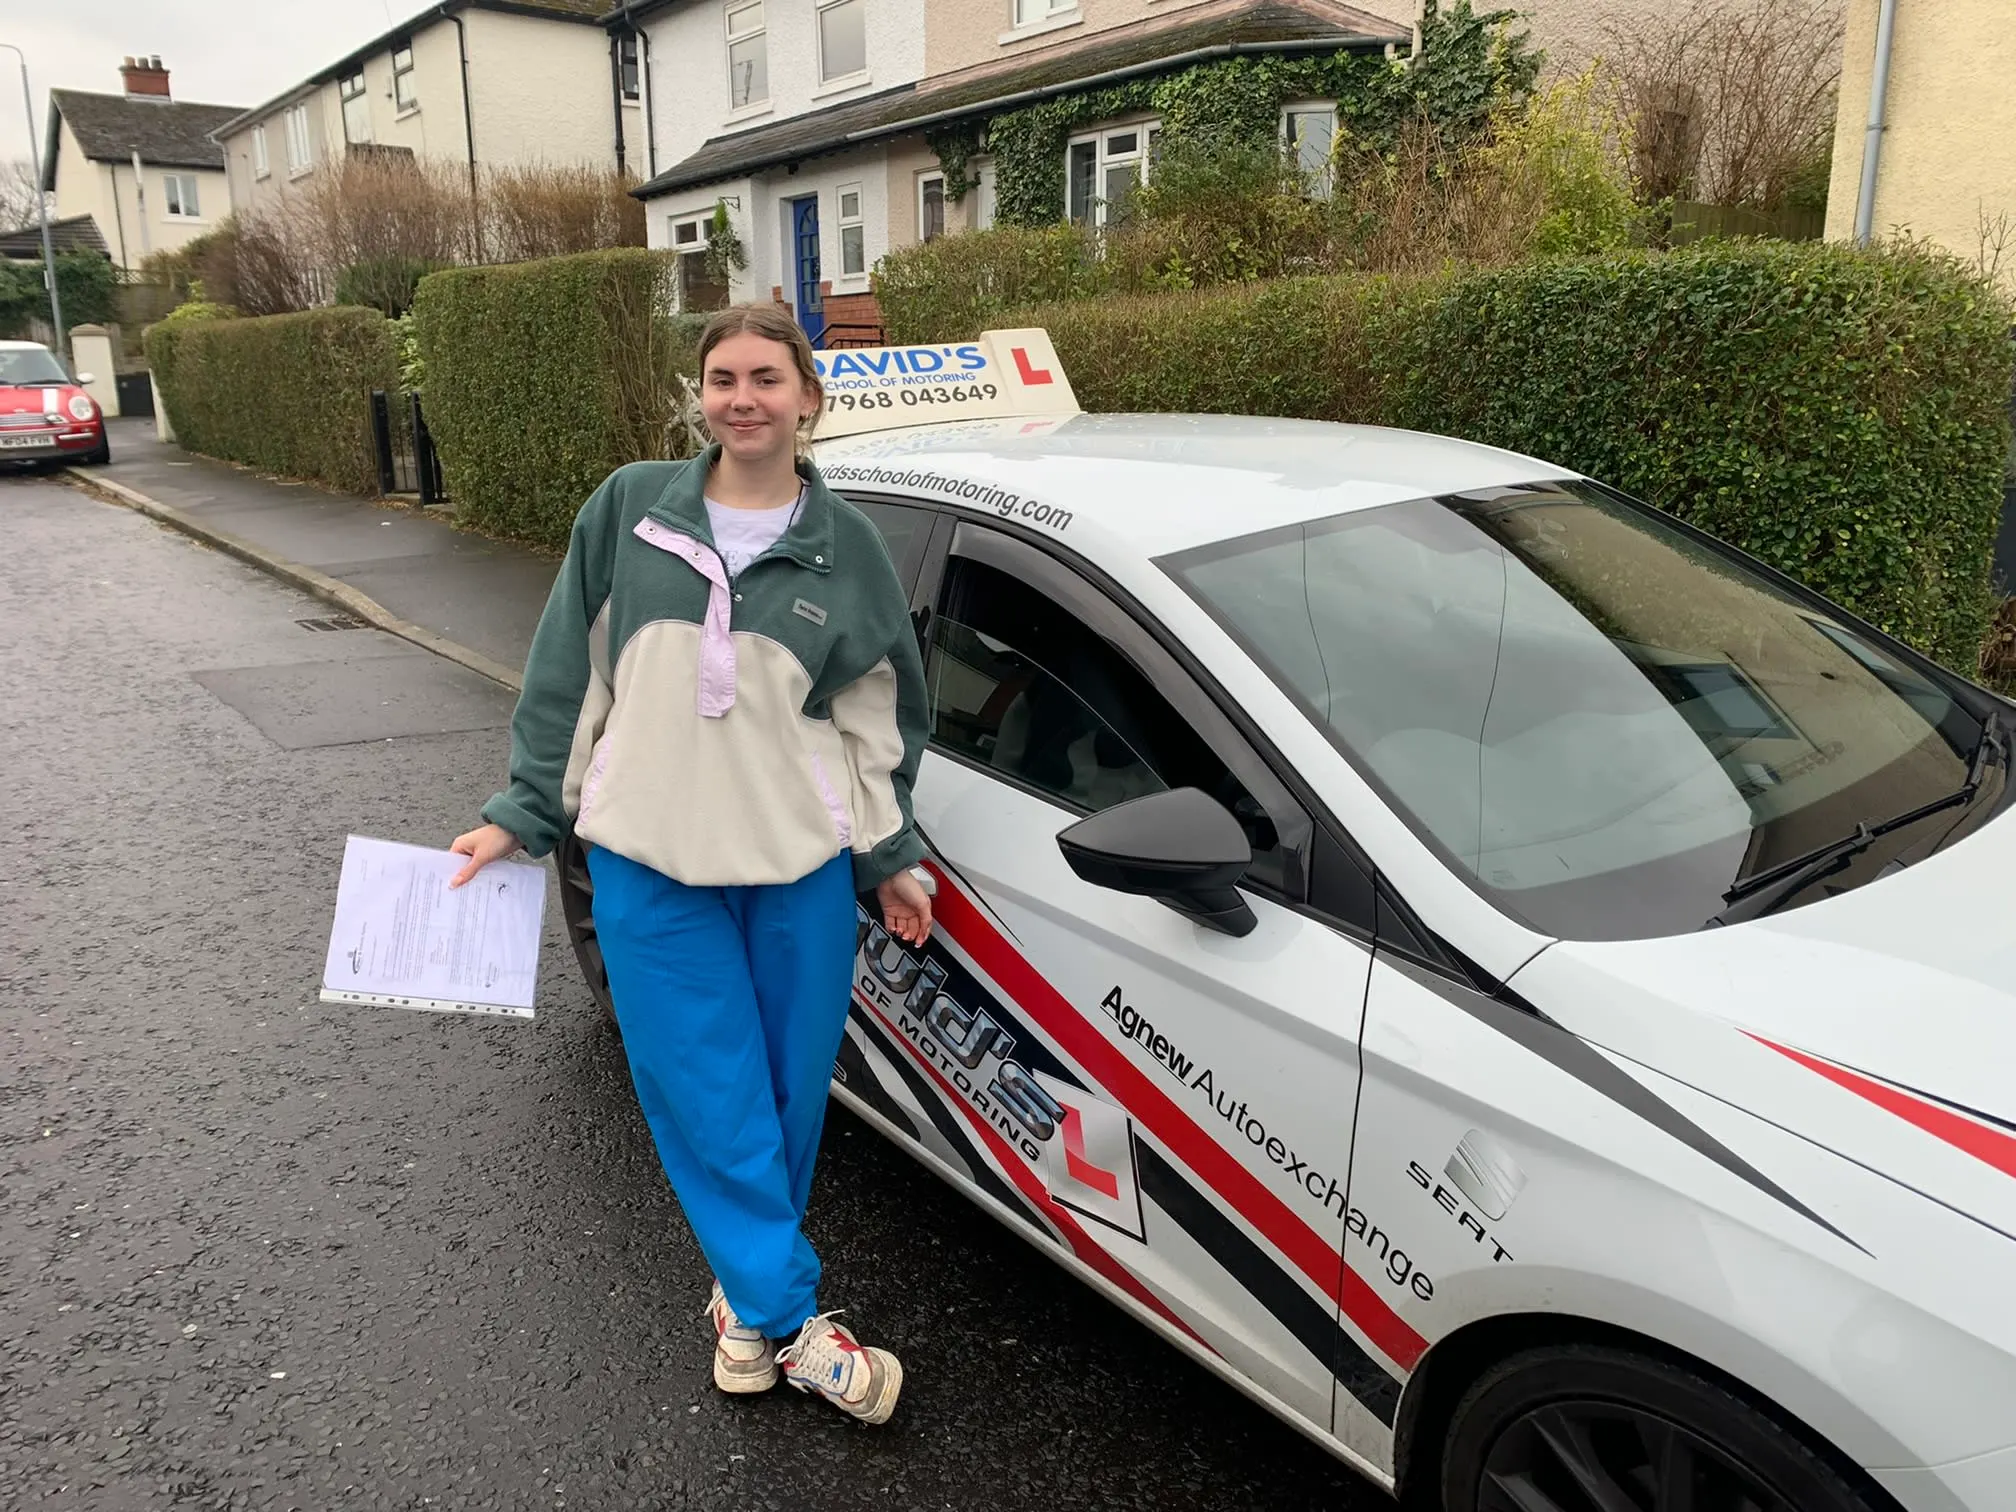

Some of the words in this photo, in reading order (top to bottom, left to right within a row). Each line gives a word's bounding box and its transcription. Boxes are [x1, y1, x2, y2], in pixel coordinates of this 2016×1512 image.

[824, 379, 877, 391] CHOOL
[880, 377, 897, 387] OF
[902, 372, 976, 384] MOTORING
[826, 391, 893, 412] 7968
[900, 383, 998, 406] 043649
[1010, 348, 1054, 386] L
[856, 902, 1067, 1141] vid's
[860, 975, 892, 1008] OF
[898, 1016, 1040, 1162] MOTORING
[1100, 985, 1194, 1080] Agnew
[1191, 1069, 1434, 1301] Autoexchange
[1405, 1160, 1514, 1264] SEAT
